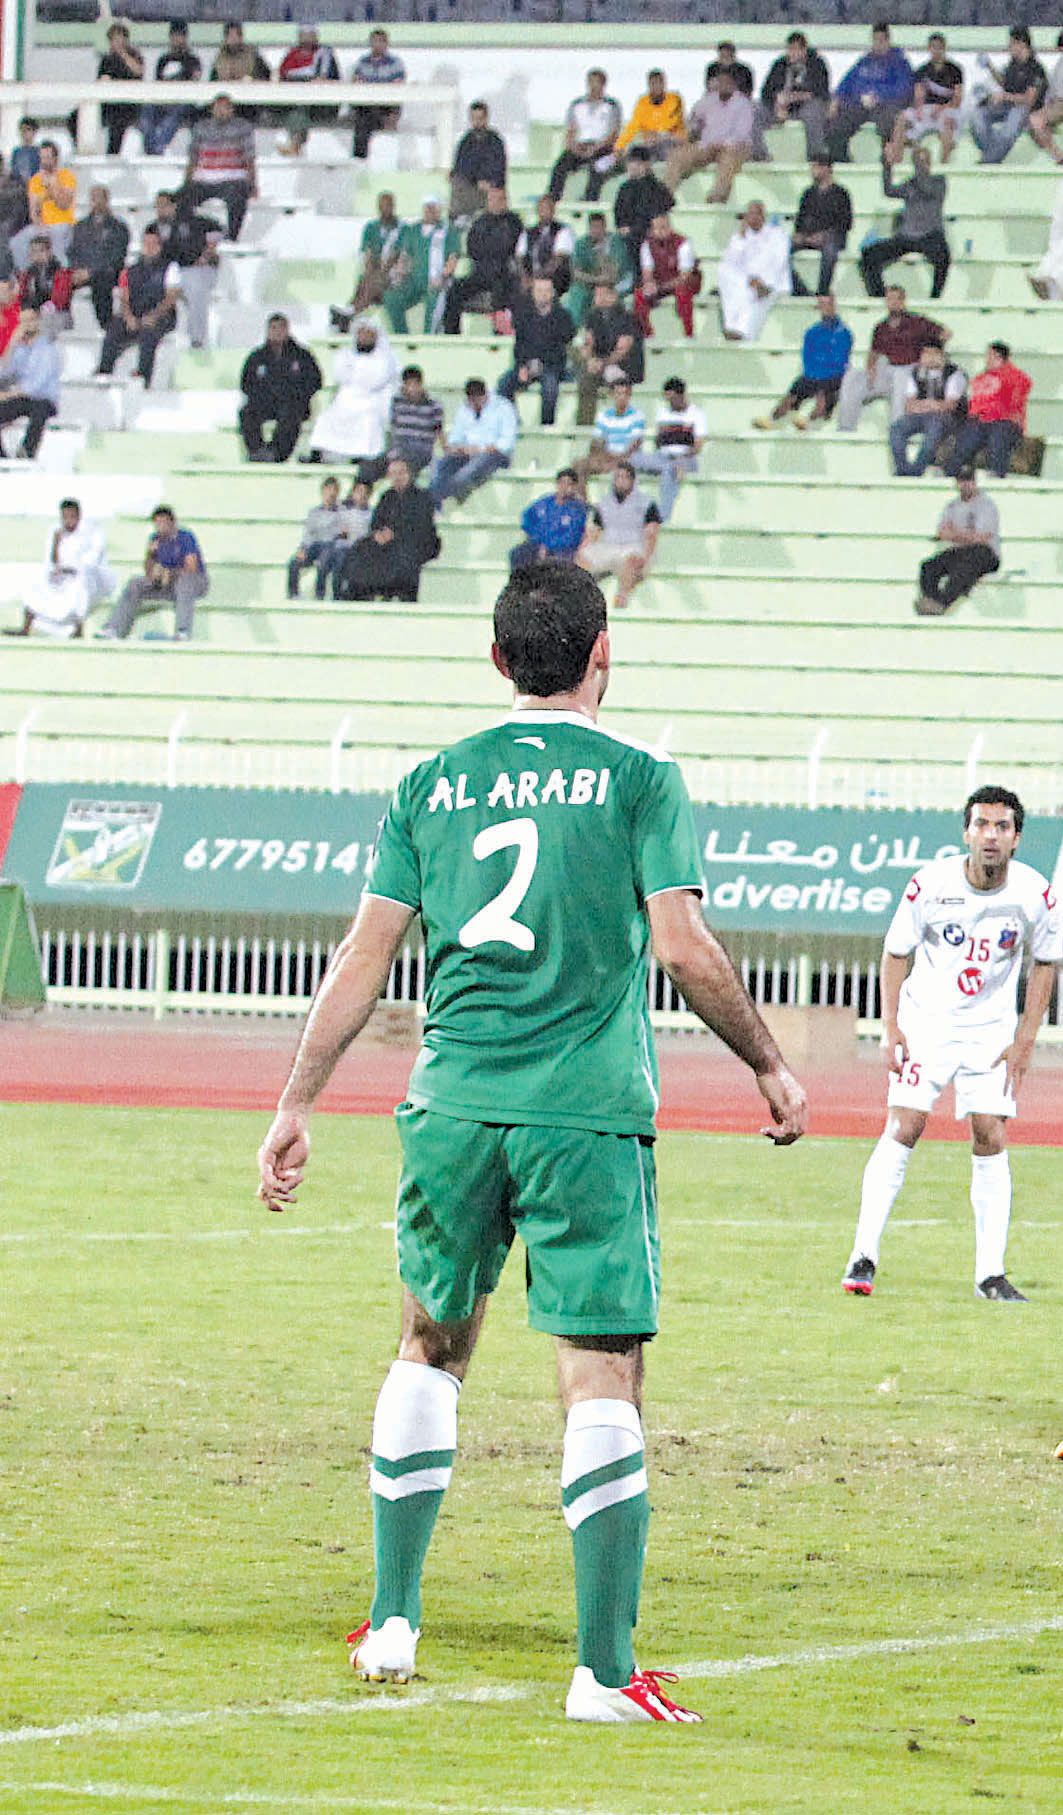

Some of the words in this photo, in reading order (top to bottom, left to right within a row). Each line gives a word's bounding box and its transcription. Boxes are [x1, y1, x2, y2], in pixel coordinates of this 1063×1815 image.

[427, 773, 477, 813] AL
[487, 768, 610, 809] ARABI
[704, 829, 838, 869] معنا
[458, 817, 539, 951] 2
[965, 936, 990, 962] 15
